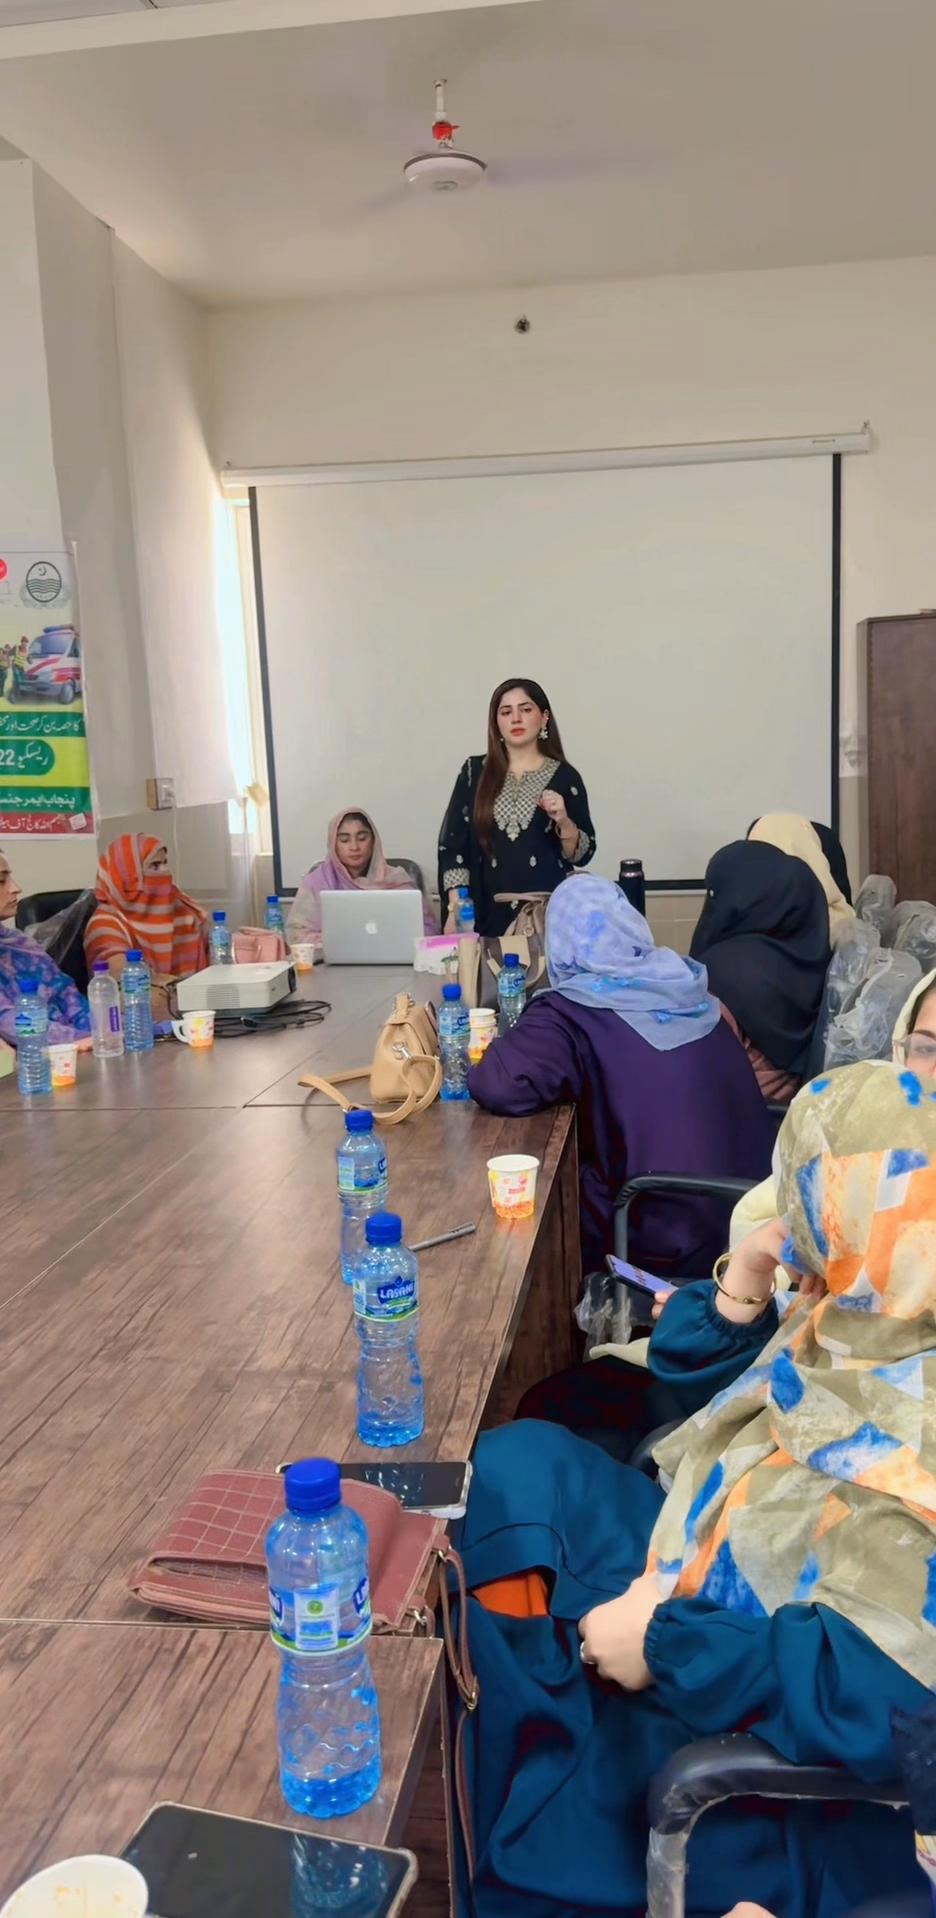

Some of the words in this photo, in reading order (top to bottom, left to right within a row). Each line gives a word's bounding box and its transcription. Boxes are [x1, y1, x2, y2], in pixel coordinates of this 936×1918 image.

[36, 714, 48, 731] کر
[0, 748, 15, 766] 22
[18, 741, 49, 768] ریسکیو
[44, 793, 76, 809] پنجاب
[379, 1284, 414, 1299] LASANI
